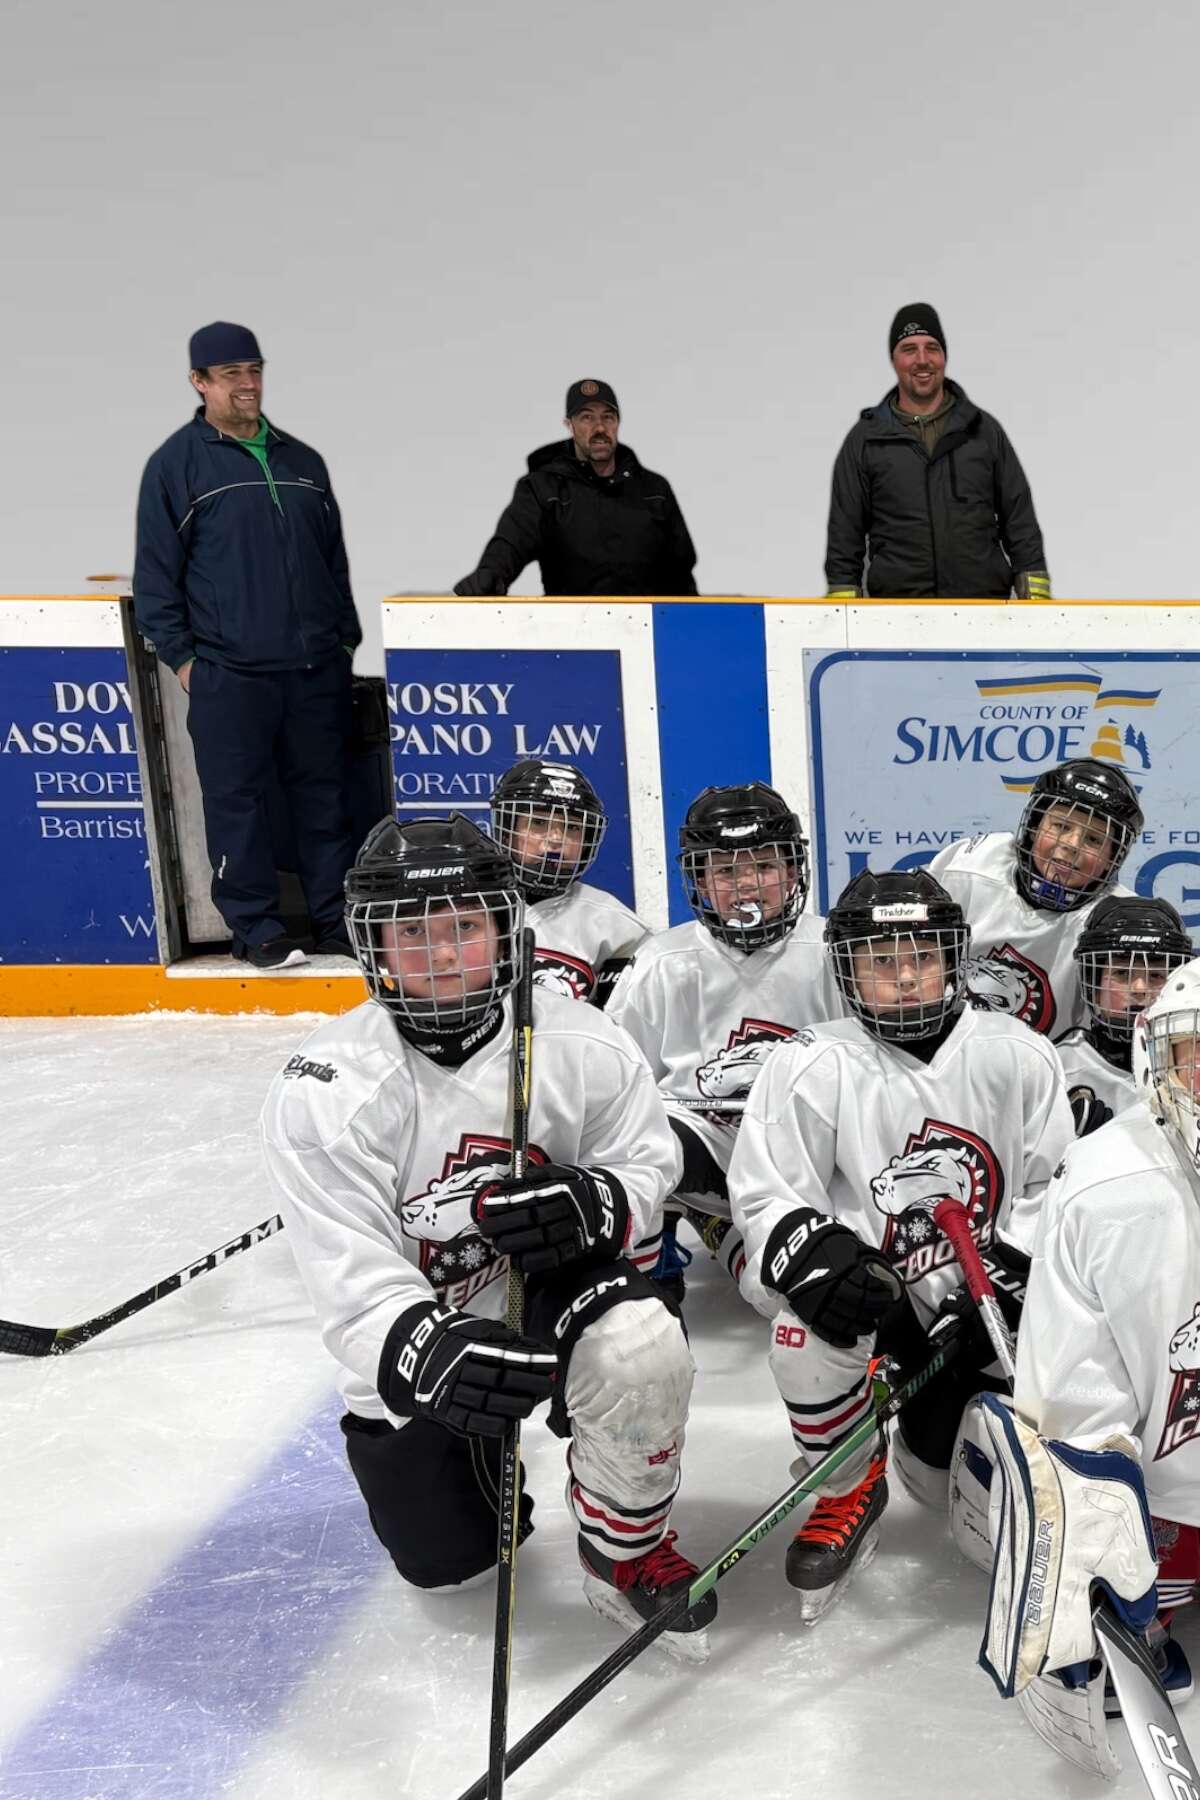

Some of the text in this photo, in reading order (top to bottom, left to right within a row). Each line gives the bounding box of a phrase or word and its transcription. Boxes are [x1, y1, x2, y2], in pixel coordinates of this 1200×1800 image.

[980, 705, 1088, 720] COUNTY OF
[514, 724, 602, 756] LAW
[893, 717, 1085, 765] SIMCOE
[392, 772, 503, 795] ORATI
[1074, 782, 1109, 799] CCM
[40, 815, 147, 839] Barrist
[845, 831, 882, 844] WE
[406, 864, 465, 880] BAUER
[1119, 934, 1160, 945] BAUER
[770, 1215, 834, 1283] BAU
[553, 1275, 628, 1340] CCM
[396, 1304, 460, 1384] BAU
[1026, 1519, 1055, 1627] BAUER
